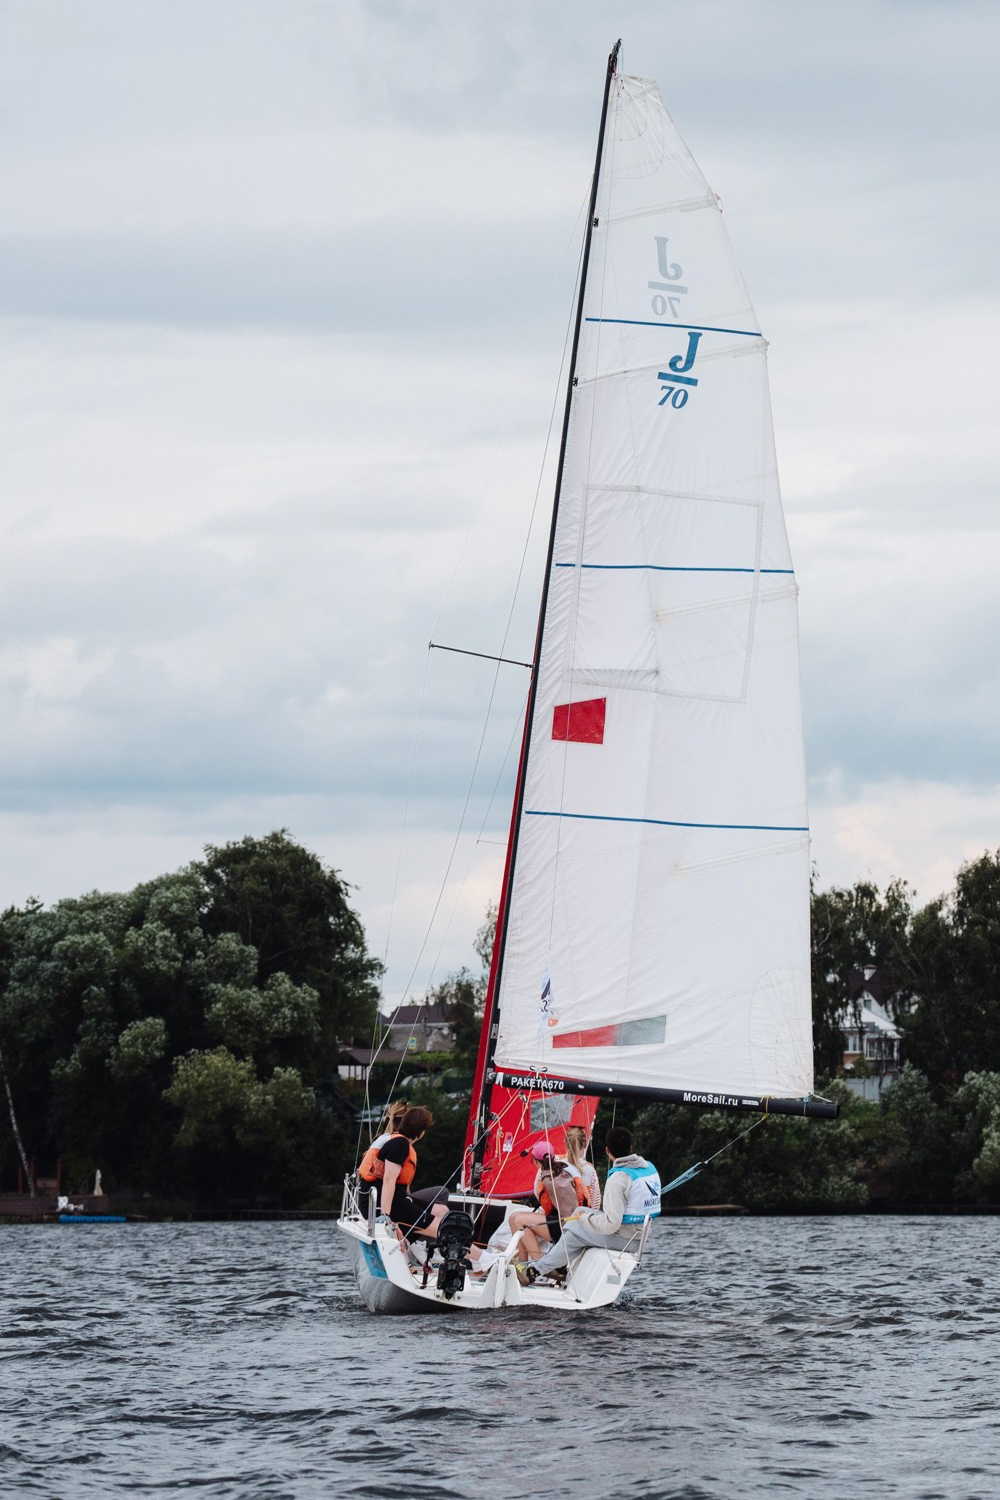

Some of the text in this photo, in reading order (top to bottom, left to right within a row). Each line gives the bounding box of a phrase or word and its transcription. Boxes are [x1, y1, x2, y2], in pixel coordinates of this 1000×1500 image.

[668, 331, 703, 373] J
[658, 385, 689, 409] 70
[683, 1092, 738, 1106] MoreSail.ru
